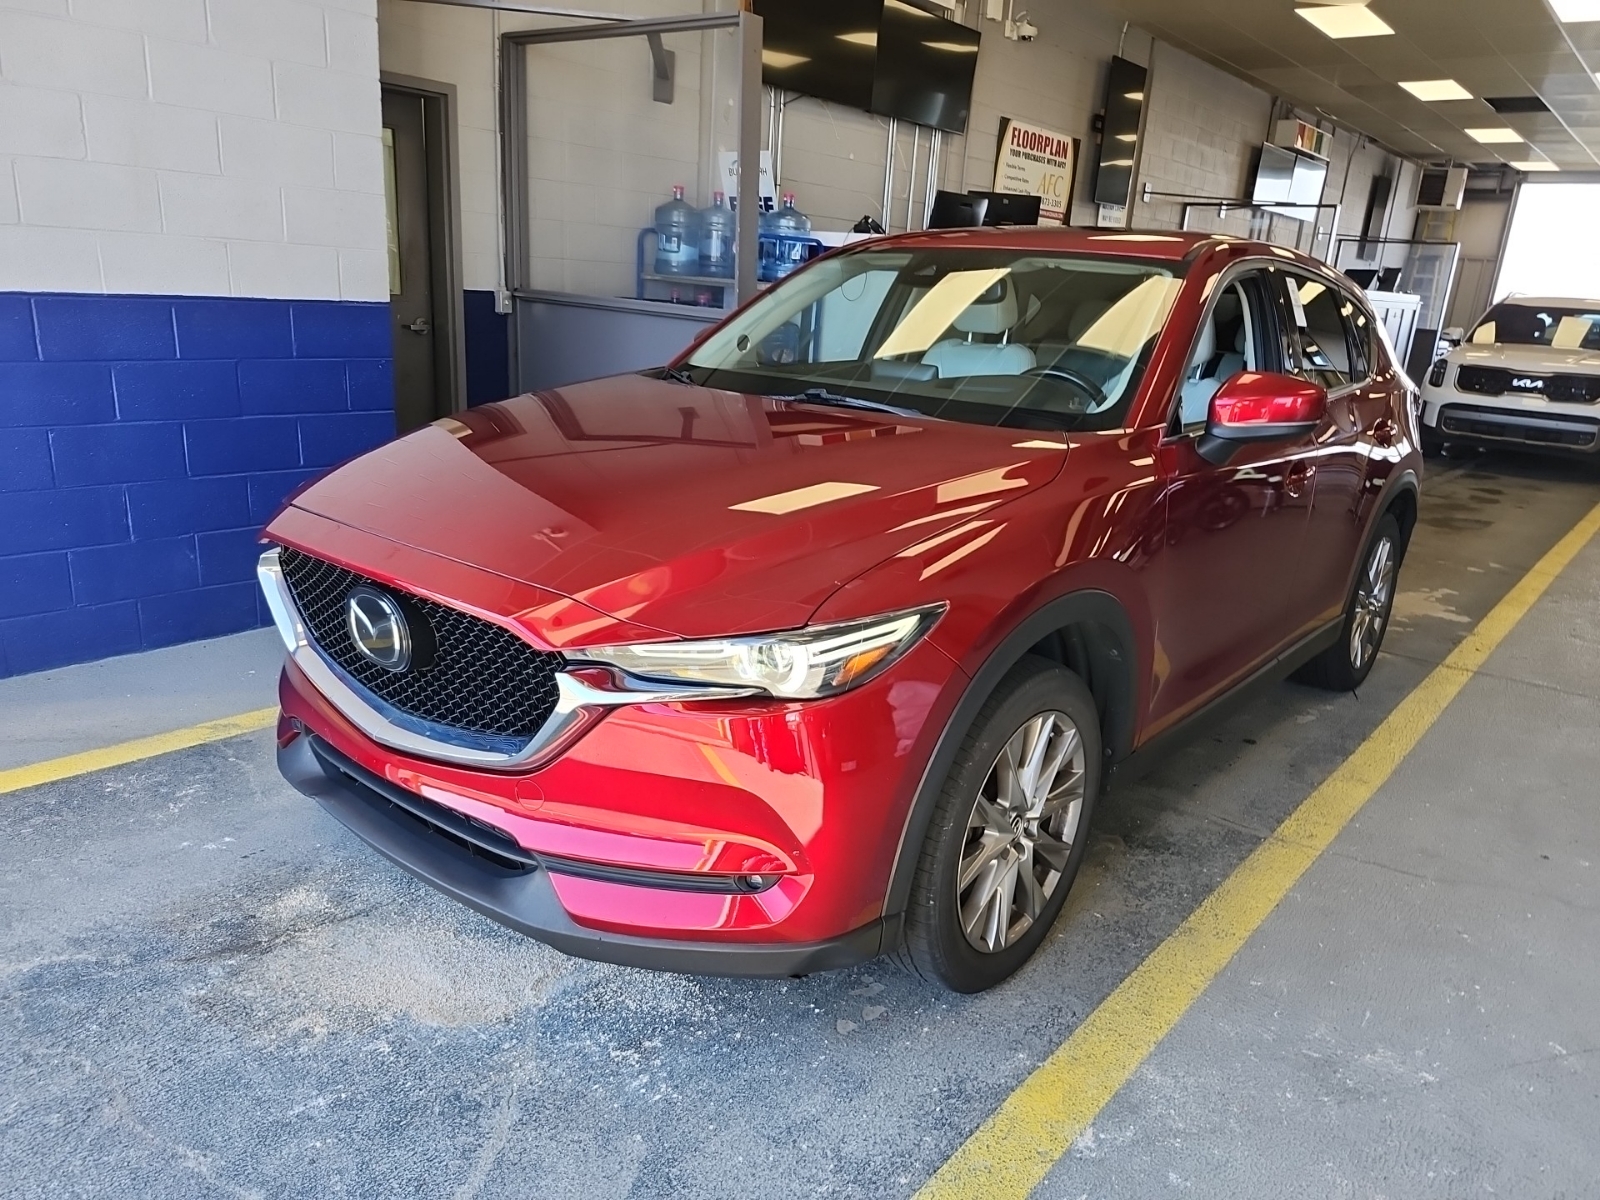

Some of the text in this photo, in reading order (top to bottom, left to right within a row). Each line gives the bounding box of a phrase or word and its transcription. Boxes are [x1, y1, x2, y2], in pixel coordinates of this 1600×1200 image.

[1011, 127, 1069, 160] FLOORPLAN
[1010, 148, 1021, 158] YOUR
[1022, 151, 1047, 165] PURCHASES
[1036, 172, 1064, 197] AFC
[1512, 378, 1543, 388] KIA
